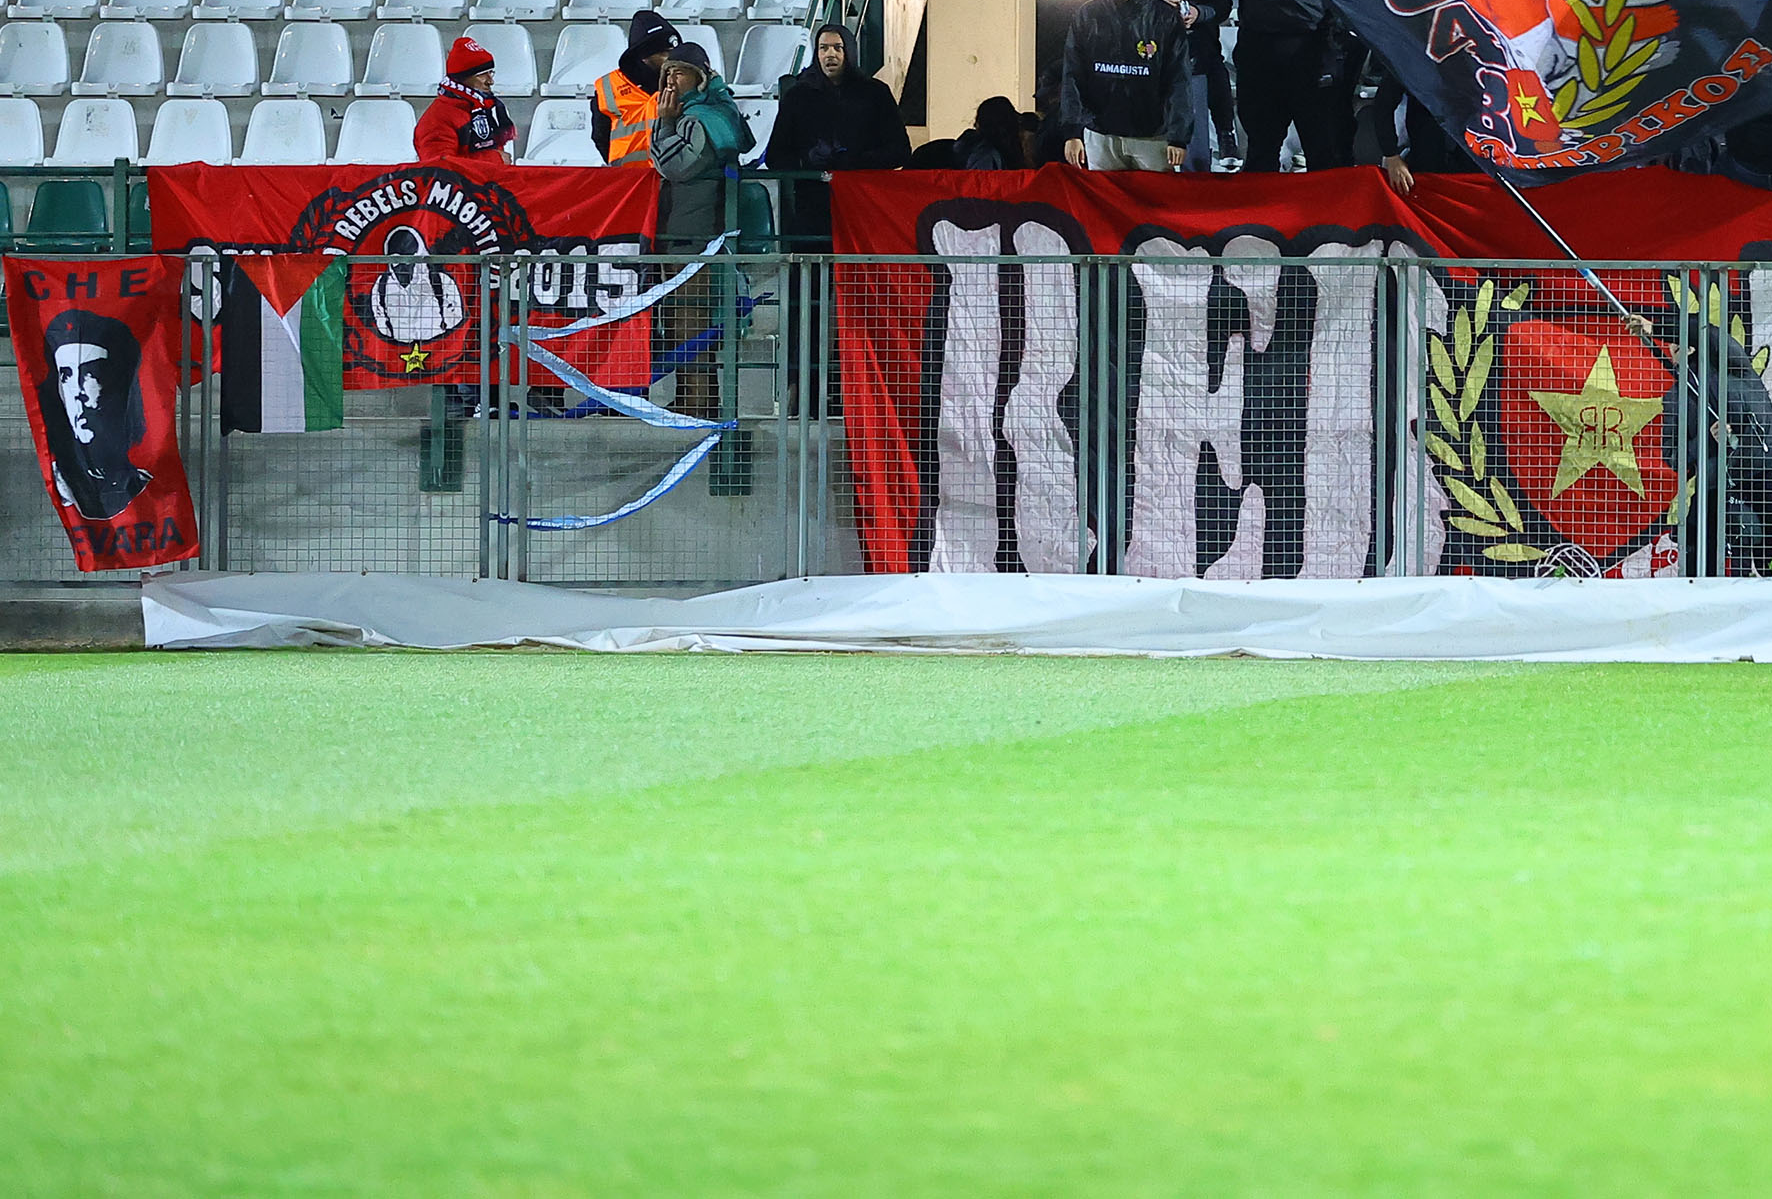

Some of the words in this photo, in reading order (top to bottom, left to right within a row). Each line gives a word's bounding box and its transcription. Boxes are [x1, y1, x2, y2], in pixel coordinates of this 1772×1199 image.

[1094, 62, 1151, 77] FAMAGUSTA
[333, 178, 419, 242] REBELS
[22, 267, 148, 301] CHE
[509, 243, 641, 317] 2015
[928, 218, 1449, 580] RED
[68, 516, 186, 557] EVARA
